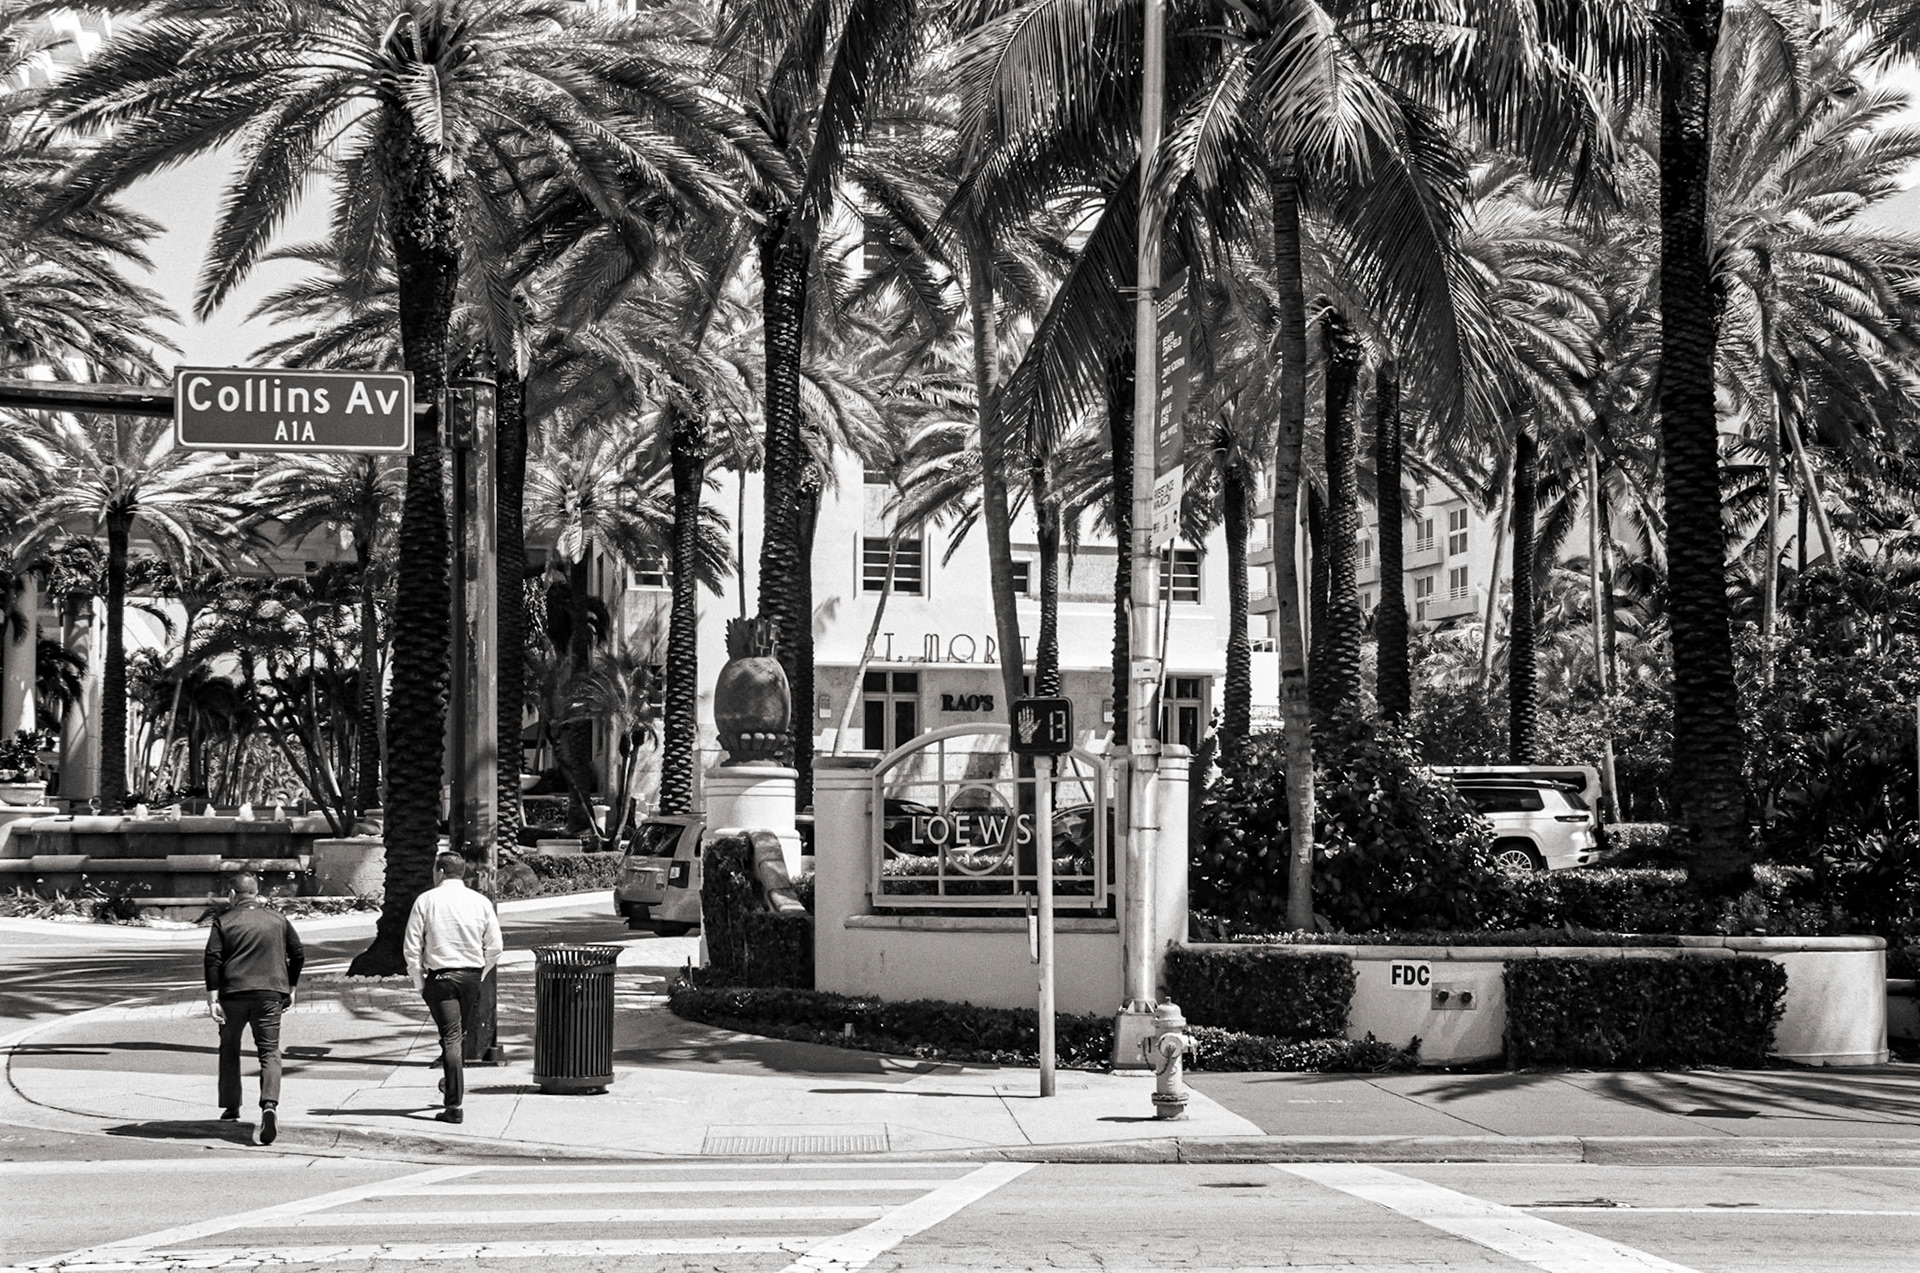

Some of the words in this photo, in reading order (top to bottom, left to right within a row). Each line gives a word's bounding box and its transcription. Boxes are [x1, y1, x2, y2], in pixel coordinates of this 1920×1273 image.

[187, 376, 331, 414] Collins
[345, 380, 399, 415] Av
[274, 420, 316, 442] A1A
[940, 693, 994, 712] RAO'S
[911, 813, 1032, 845] LOEWS
[1391, 964, 1430, 986] FDC
